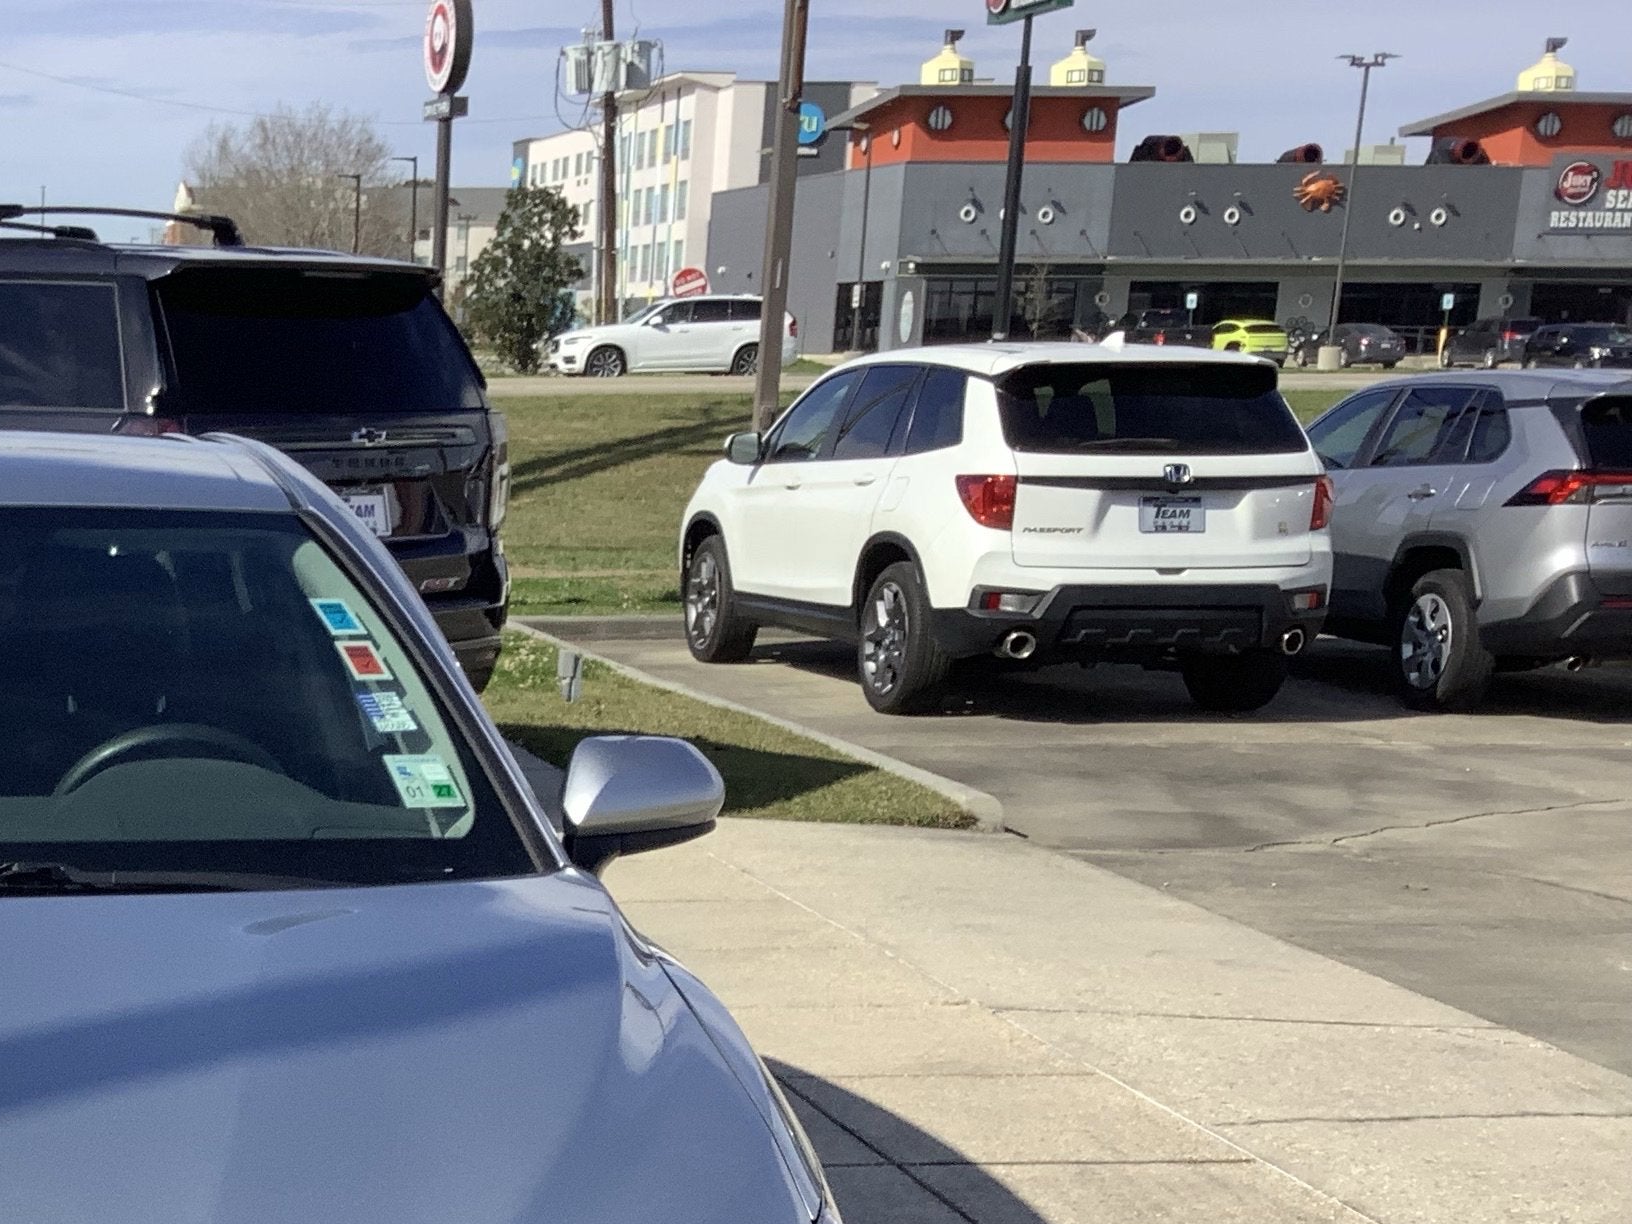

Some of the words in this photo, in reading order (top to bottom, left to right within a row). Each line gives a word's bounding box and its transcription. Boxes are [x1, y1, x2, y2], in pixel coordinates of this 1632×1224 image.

[1153, 502, 1191, 519] TEAM
[1022, 526, 1085, 534] PASSPORT
[406, 785, 424, 798] 01
